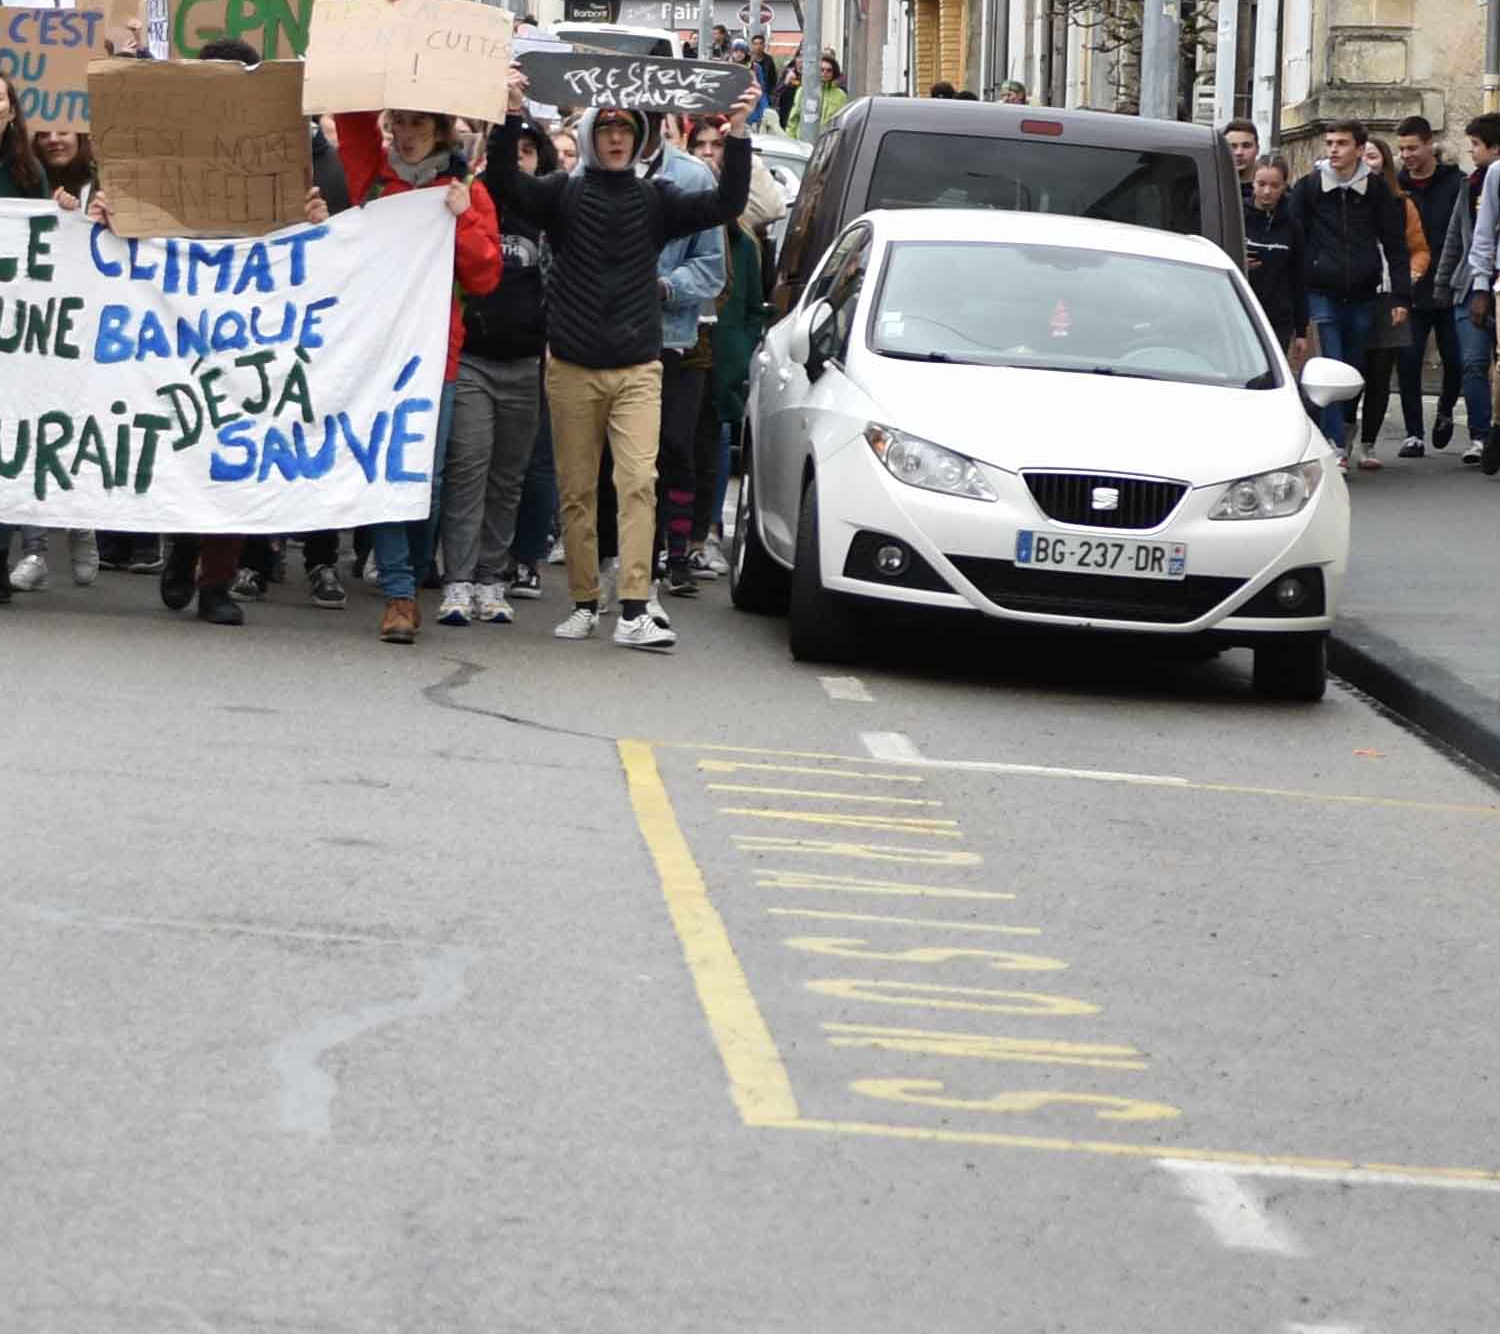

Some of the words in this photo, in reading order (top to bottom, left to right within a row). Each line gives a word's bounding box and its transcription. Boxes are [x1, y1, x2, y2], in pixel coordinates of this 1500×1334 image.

[8, 10, 104, 48] C'EST
[90, 224, 331, 296] CLIMAT
[92, 295, 339, 364] BANQUE
[157, 347, 315, 452] DÉJÀ
[208, 355, 433, 484] SAUVÉ
[1035, 536, 1166, 573] BG-237-DR
